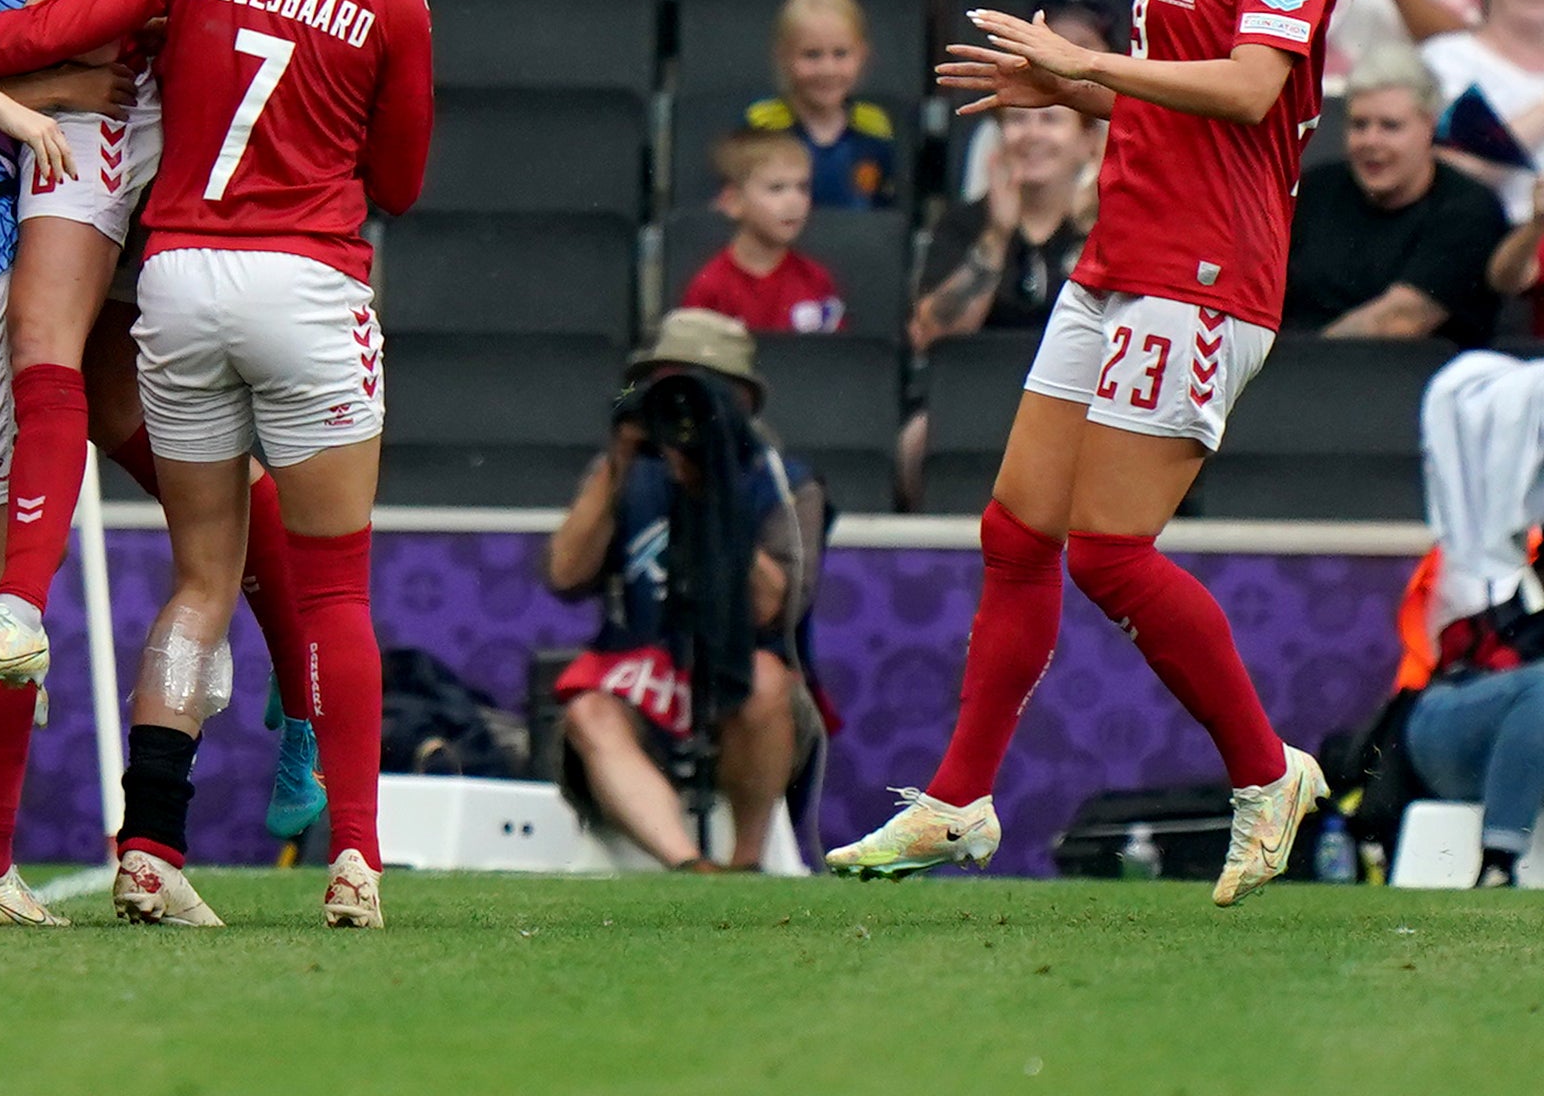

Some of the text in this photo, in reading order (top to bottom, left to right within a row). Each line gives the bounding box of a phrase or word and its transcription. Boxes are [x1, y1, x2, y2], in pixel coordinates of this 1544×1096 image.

[203, 27, 296, 201] 7
[1096, 326, 1172, 410] 23
[309, 642, 325, 717] DANMARK
